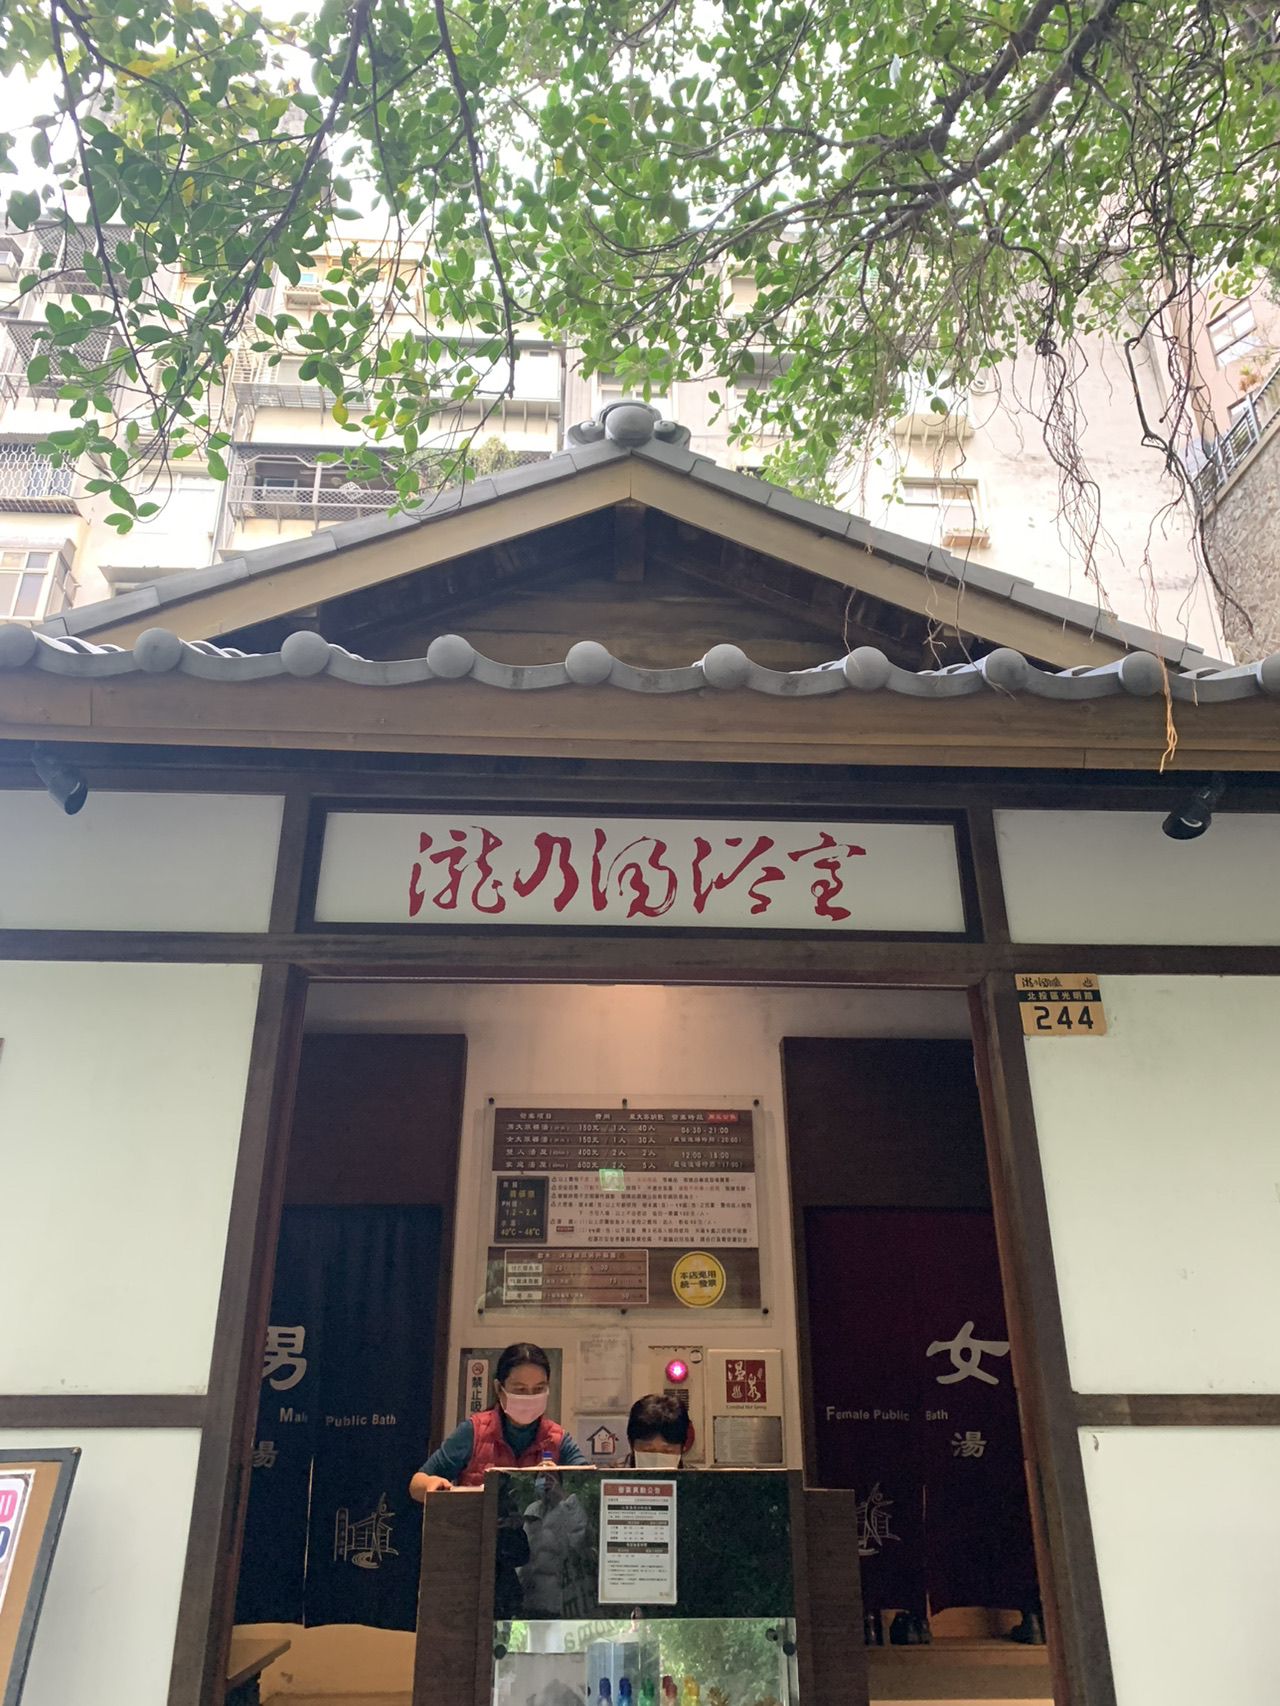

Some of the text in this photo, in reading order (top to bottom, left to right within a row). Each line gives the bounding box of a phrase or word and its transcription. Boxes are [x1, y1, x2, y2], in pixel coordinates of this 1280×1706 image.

[1027, 990, 1094, 1001] 北投區光明路
[1033, 1005, 1094, 1030] 244
[679, 1270, 717, 1280] 本店免用
[679, 1279, 718, 1289] 統一發票
[925, 1320, 1010, 1386] 女
[325, 1415, 367, 1427] Public
[371, 1413, 397, 1426] Bath
[825, 1405, 949, 1422] Female Public Bath
[951, 1431, 988, 1458] 湯
